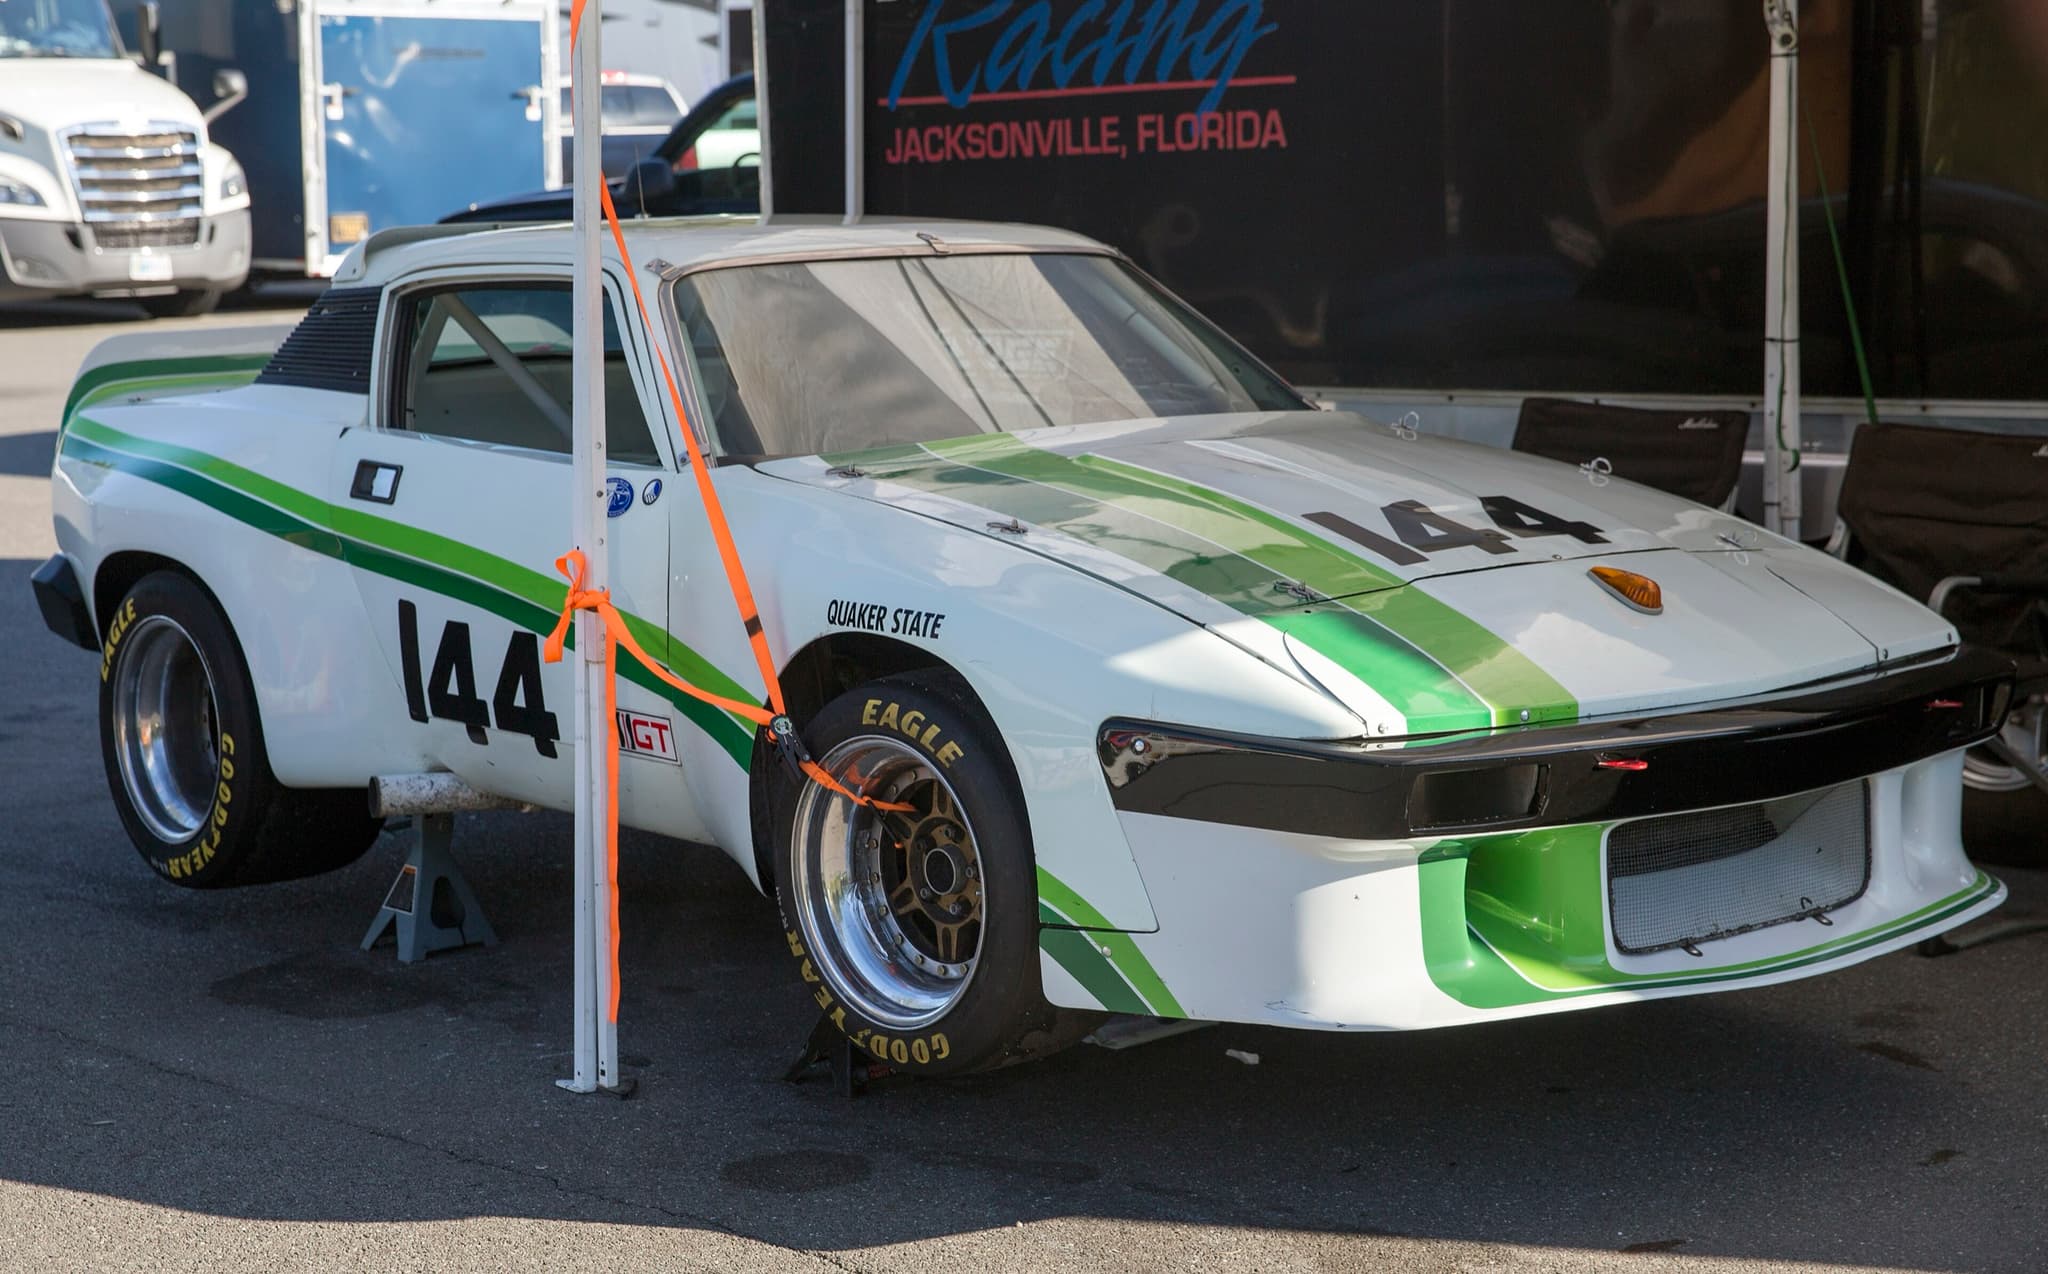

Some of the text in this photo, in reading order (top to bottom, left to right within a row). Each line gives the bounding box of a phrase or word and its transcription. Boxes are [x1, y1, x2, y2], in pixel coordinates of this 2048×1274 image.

[887, 0, 1279, 136] Racing
[886, 109, 1288, 164] JACKSONVILLE, FLORIDA
[1301, 496, 1612, 566] 144
[101, 598, 137, 684] EAGLE
[827, 599, 945, 640] QUAKER STATE
[398, 598, 560, 759] 144
[862, 699, 964, 769] EAGLE
[168, 732, 235, 880] GOODYEAR
